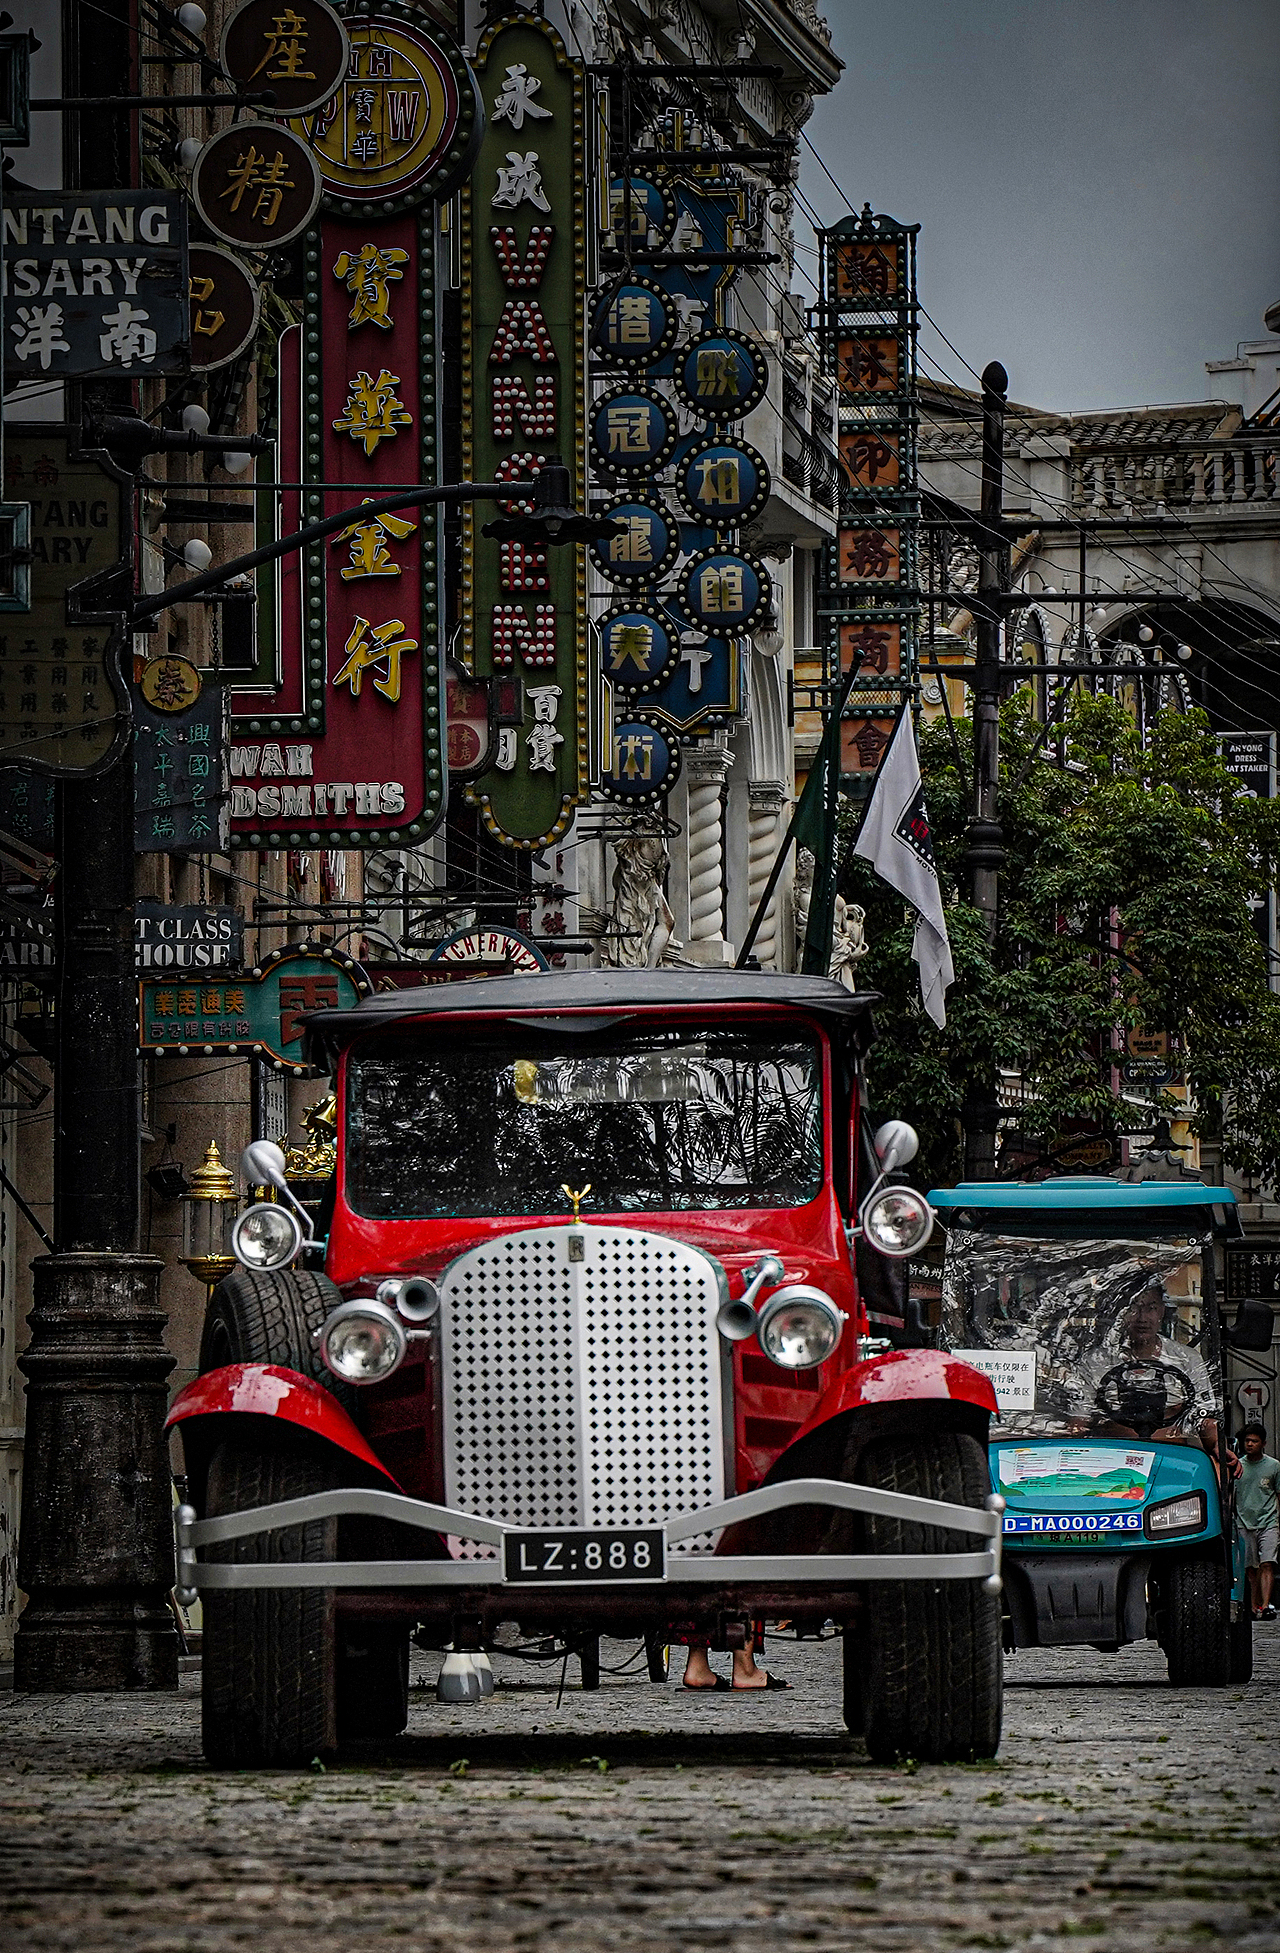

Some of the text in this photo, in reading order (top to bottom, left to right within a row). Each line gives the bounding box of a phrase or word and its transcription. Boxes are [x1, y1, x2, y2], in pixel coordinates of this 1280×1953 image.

[386, 90, 421, 142] W
[329, 242, 420, 704] 寶華金行
[524, 684, 565, 773] 百貨
[230, 742, 314, 778] WAH
[186, 722, 213, 840] 興國名茶
[159, 917, 233, 940] CLASS
[135, 943, 231, 969] HOUSE
[1004, 1515, 1139, 1531] D-MA000246
[519, 1540, 652, 1572] LZ:888
